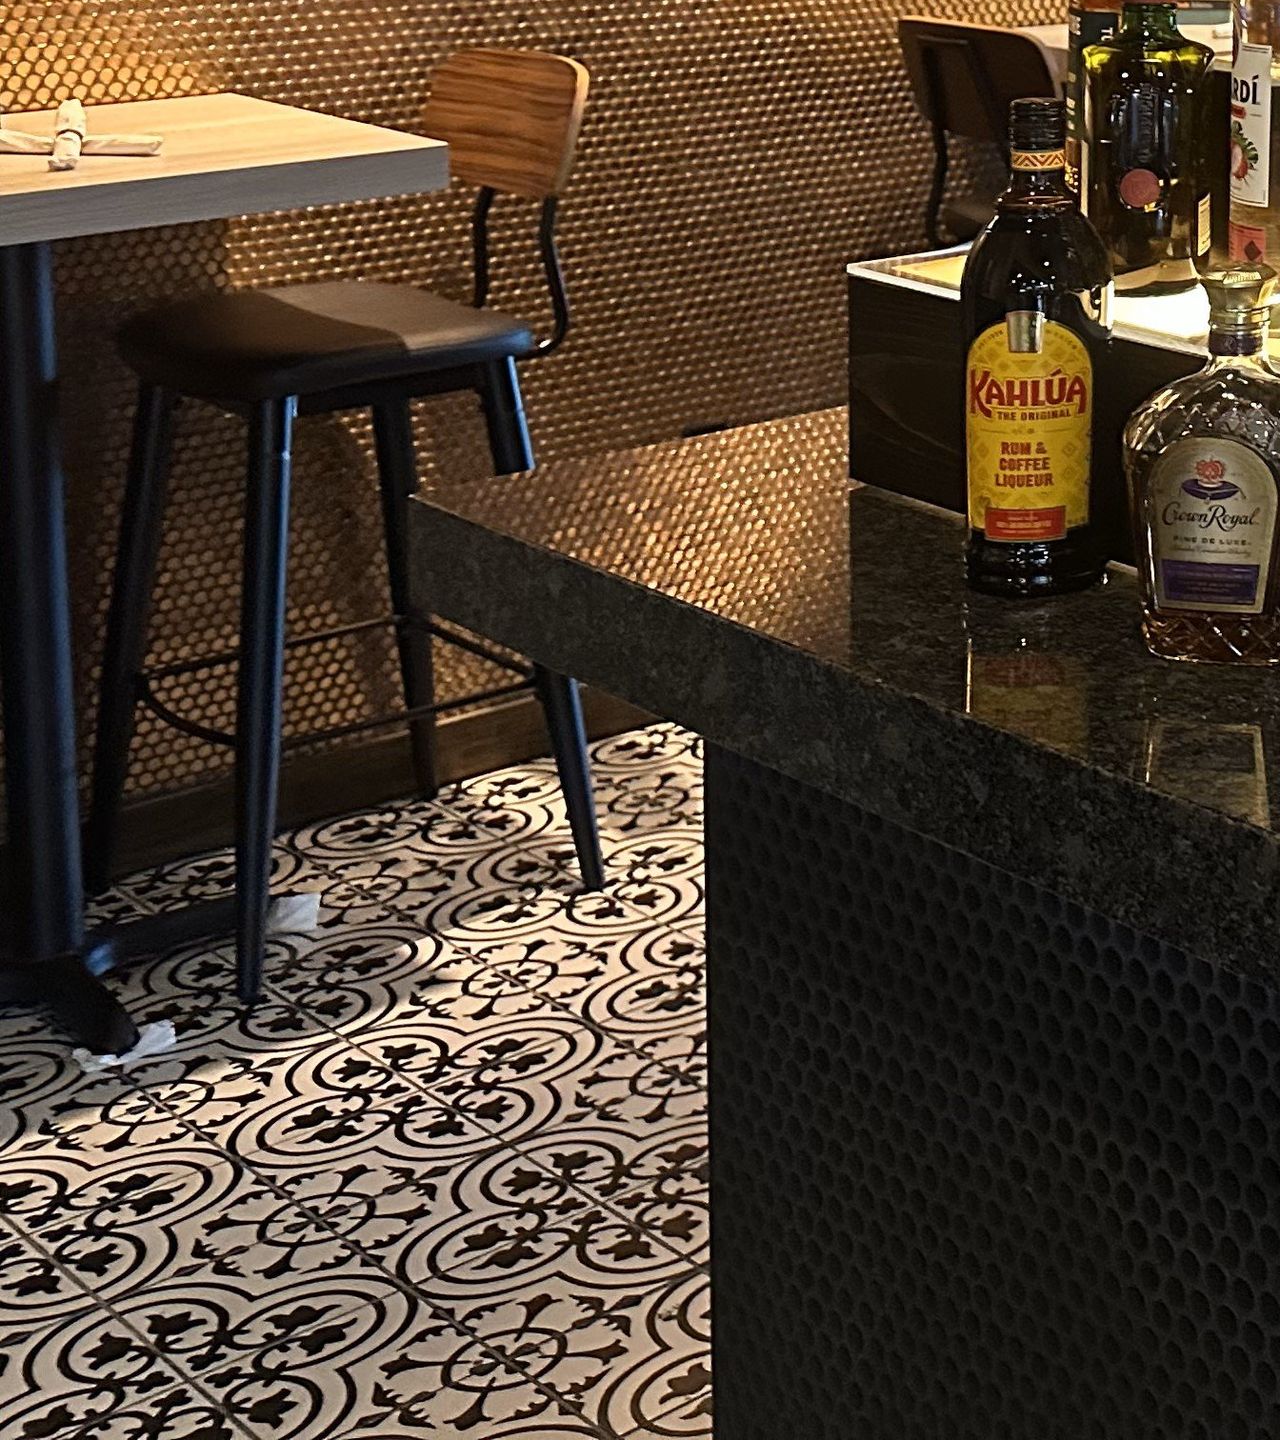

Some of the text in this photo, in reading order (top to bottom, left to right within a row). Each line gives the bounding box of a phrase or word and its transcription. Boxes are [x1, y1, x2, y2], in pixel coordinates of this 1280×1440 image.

[970, 368, 1088, 419] KAHLÚA
[997, 408, 1072, 421] THE ORIGINAL
[1001, 441, 1048, 456] RUM &
[998, 456, 1051, 471] COFFEE
[994, 472, 1054, 489] LIQUEUR
[1161, 501, 1261, 533] Crown Royal
